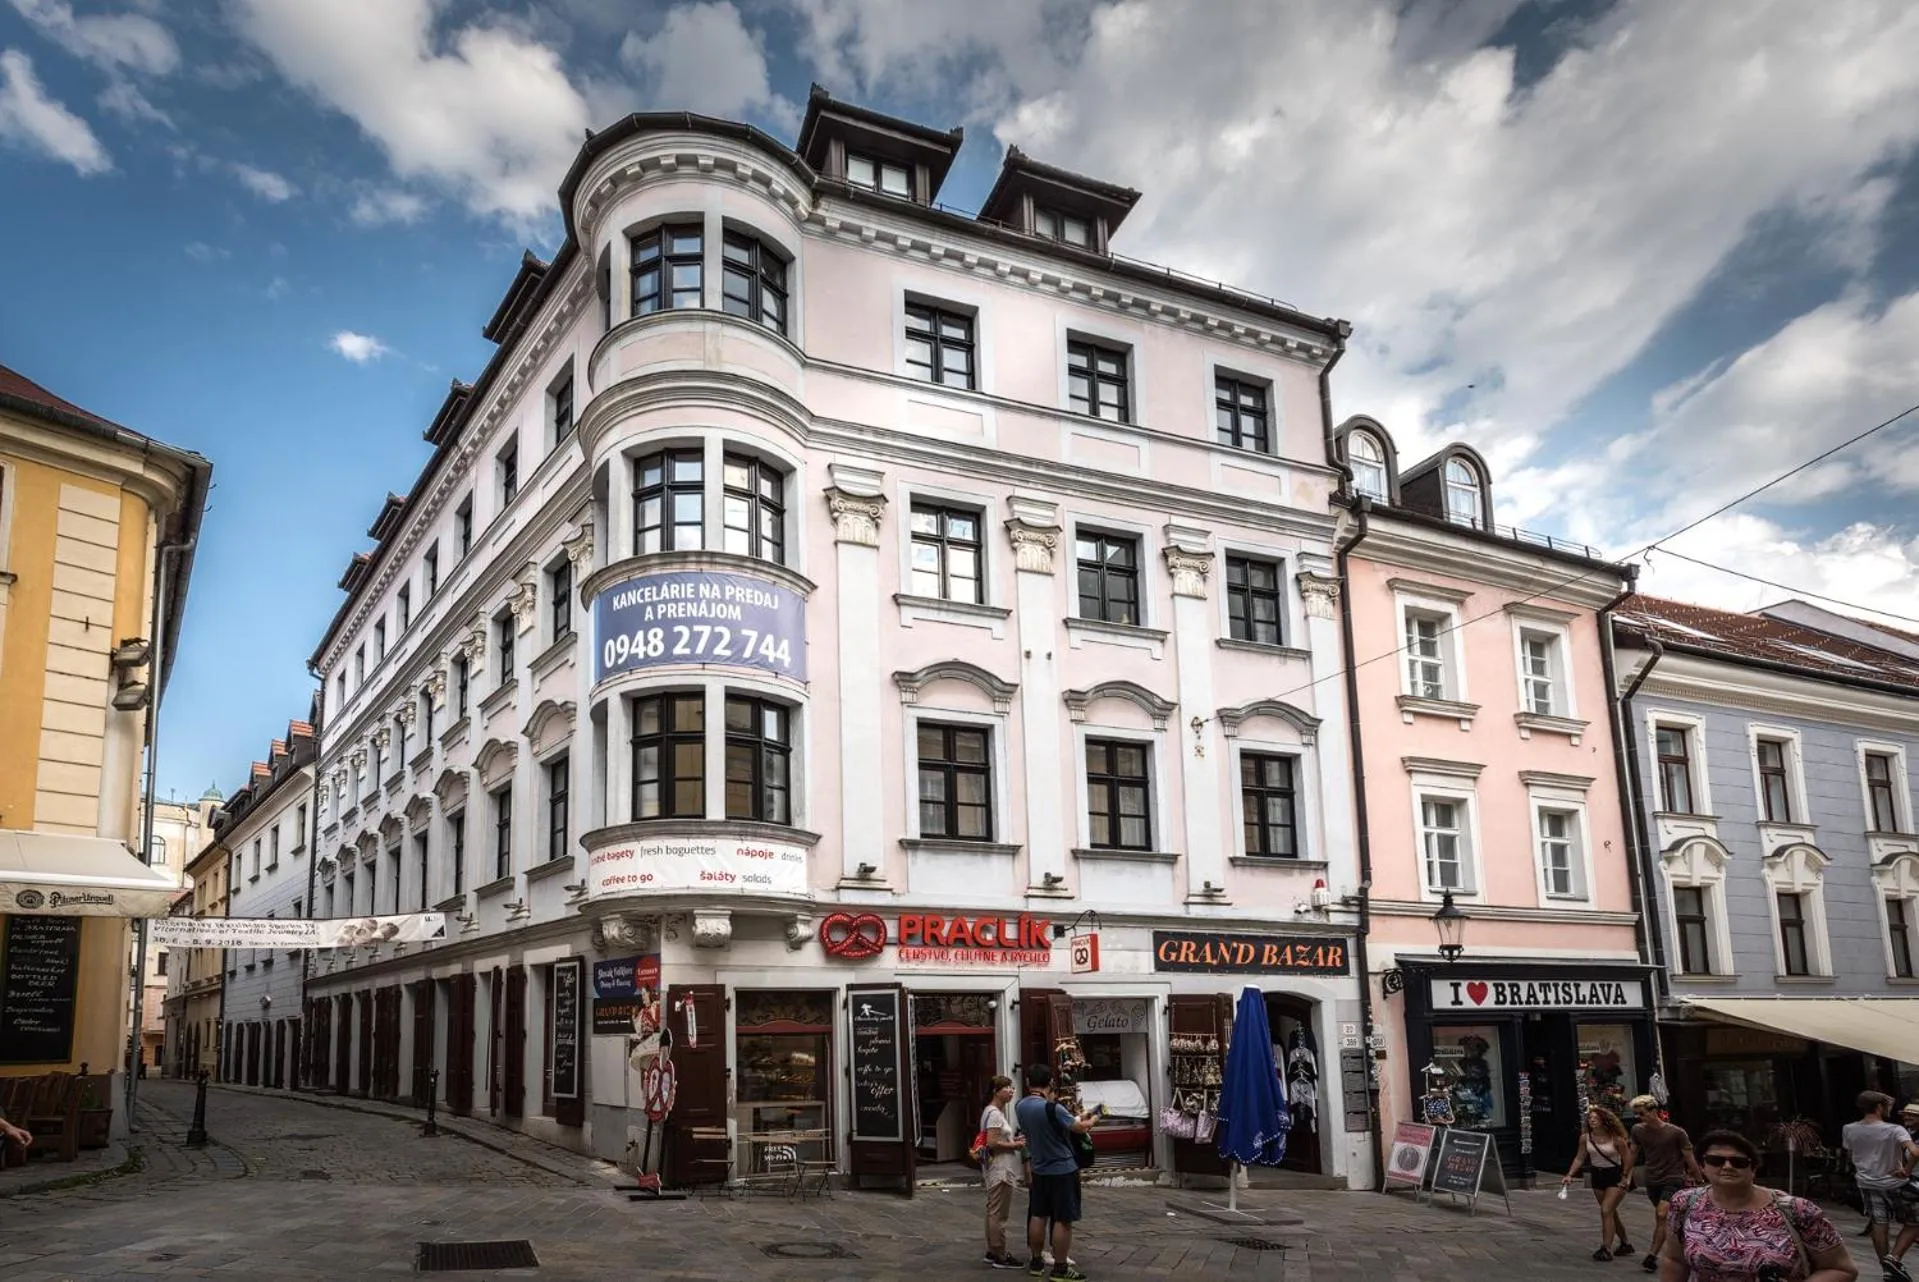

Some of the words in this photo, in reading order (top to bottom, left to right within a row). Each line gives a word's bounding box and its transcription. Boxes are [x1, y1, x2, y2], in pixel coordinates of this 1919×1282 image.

[613, 581, 696, 611] KANCELÁRIE
[699, 583, 723, 600] NA
[725, 586, 779, 610] PREDAJ
[644, 606, 655, 621] A
[657, 600, 742, 621] PRENÁJOM
[604, 627, 665, 669] 0948
[672, 625, 733, 656] 272
[741, 629, 792, 668] 744
[607, 849, 635, 861] bagety
[640, 845, 663, 858] fresh
[666, 845, 717, 857] baguettes
[736, 846, 775, 860] nápoje
[602, 874, 626, 887] coffee
[627, 875, 637, 883] to
[639, 873, 654, 885] go
[742, 874, 772, 884] salads
[898, 911, 1052, 949] PRACLÍK
[1010, 951, 1050, 963] RYCHLO
[1158, 939, 1256, 966] GRAND
[1260, 942, 1344, 969] BAZAR
[1449, 982, 1464, 1006] I
[1492, 982, 1627, 1006] BRATISLAVA
[1087, 1013, 1129, 1032] Gelato
